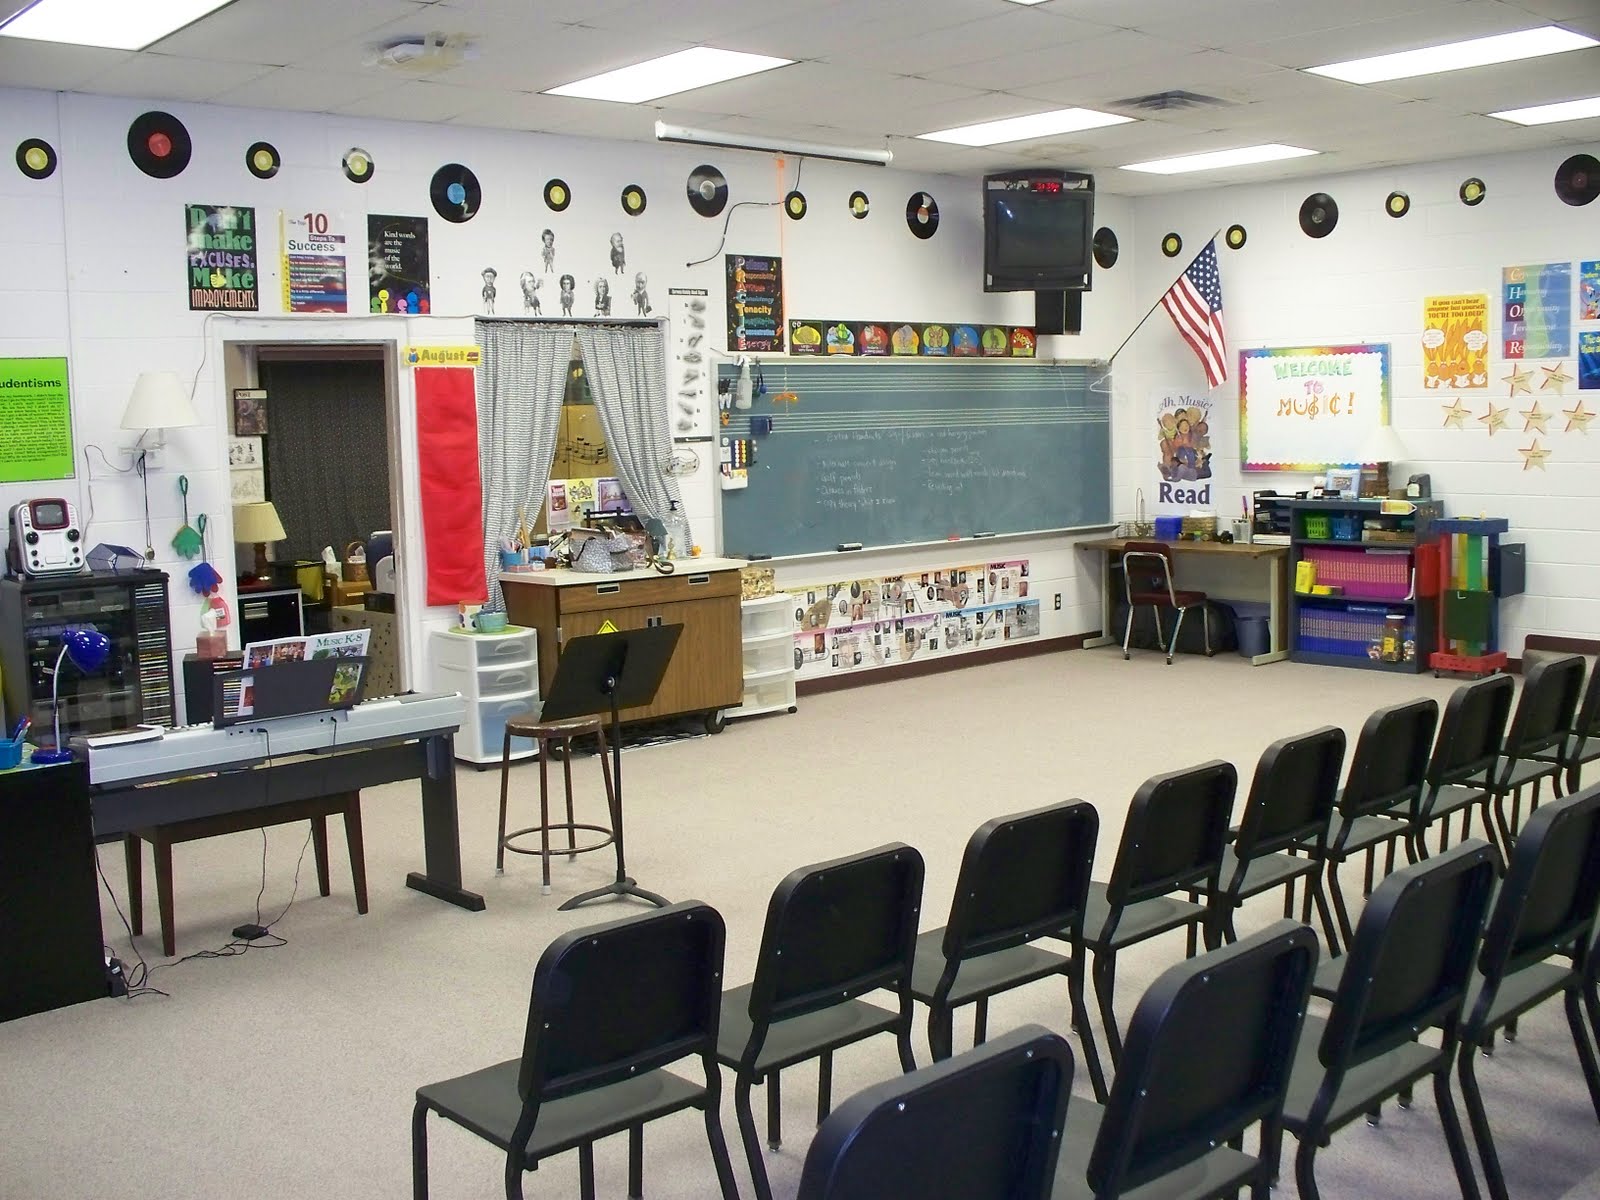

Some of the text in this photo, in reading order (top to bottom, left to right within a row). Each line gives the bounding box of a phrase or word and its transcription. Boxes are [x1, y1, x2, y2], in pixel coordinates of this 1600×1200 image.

[303, 212, 328, 234] 10
[288, 239, 335, 251] Success
[193, 267, 254, 289] Mke
[191, 289, 257, 308] IMPROVEMENTS.
[735, 303, 772, 316] Tenacity
[737, 337, 771, 350] Energy
[421, 349, 465, 364] August
[1273, 358, 1353, 380] WELCOME
[1304, 380, 1324, 395] TO
[1178, 395, 1213, 410] Music!
[1159, 482, 1210, 505] Read
[884, 575, 903, 583] MUSIC
[834, 626, 853, 635] MUSIC
